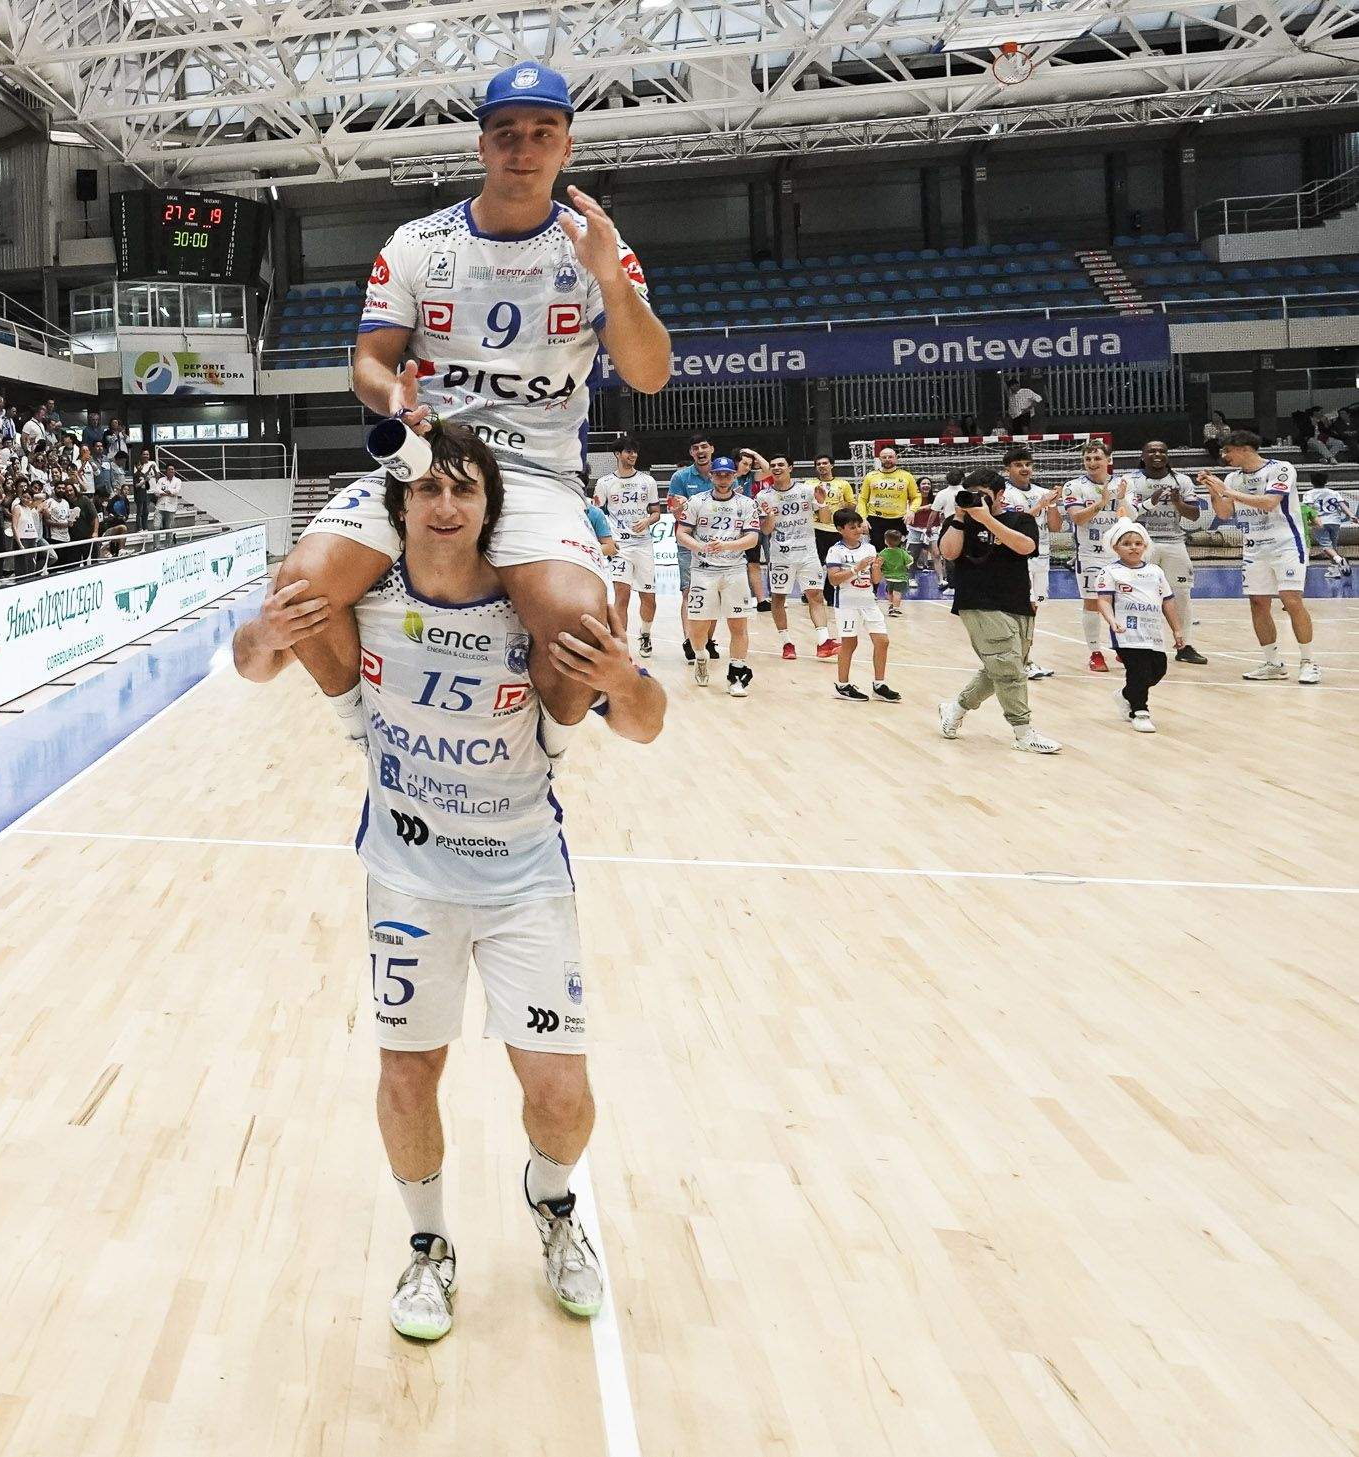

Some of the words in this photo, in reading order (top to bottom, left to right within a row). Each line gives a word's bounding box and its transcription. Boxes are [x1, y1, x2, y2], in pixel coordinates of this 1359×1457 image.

[165, 204, 182, 220] 27
[188, 207, 196, 220] 2
[210, 208, 222, 224] 19
[173, 231, 208, 248] 30:00
[482, 301, 522, 350] 9
[892, 326, 1122, 365] Pontevedra
[602, 344, 807, 379] Ptevedra
[622, 491, 638, 504] 54
[1317, 497, 1337, 512] 18
[781, 501, 800, 516] 89
[710, 516, 731, 530] 23
[771, 573, 789, 585] 89
[427, 627, 491, 652] ence
[412, 671, 481, 711] 15
[407, 782, 428, 803] DE
[433, 797, 510, 814] GALICIA
